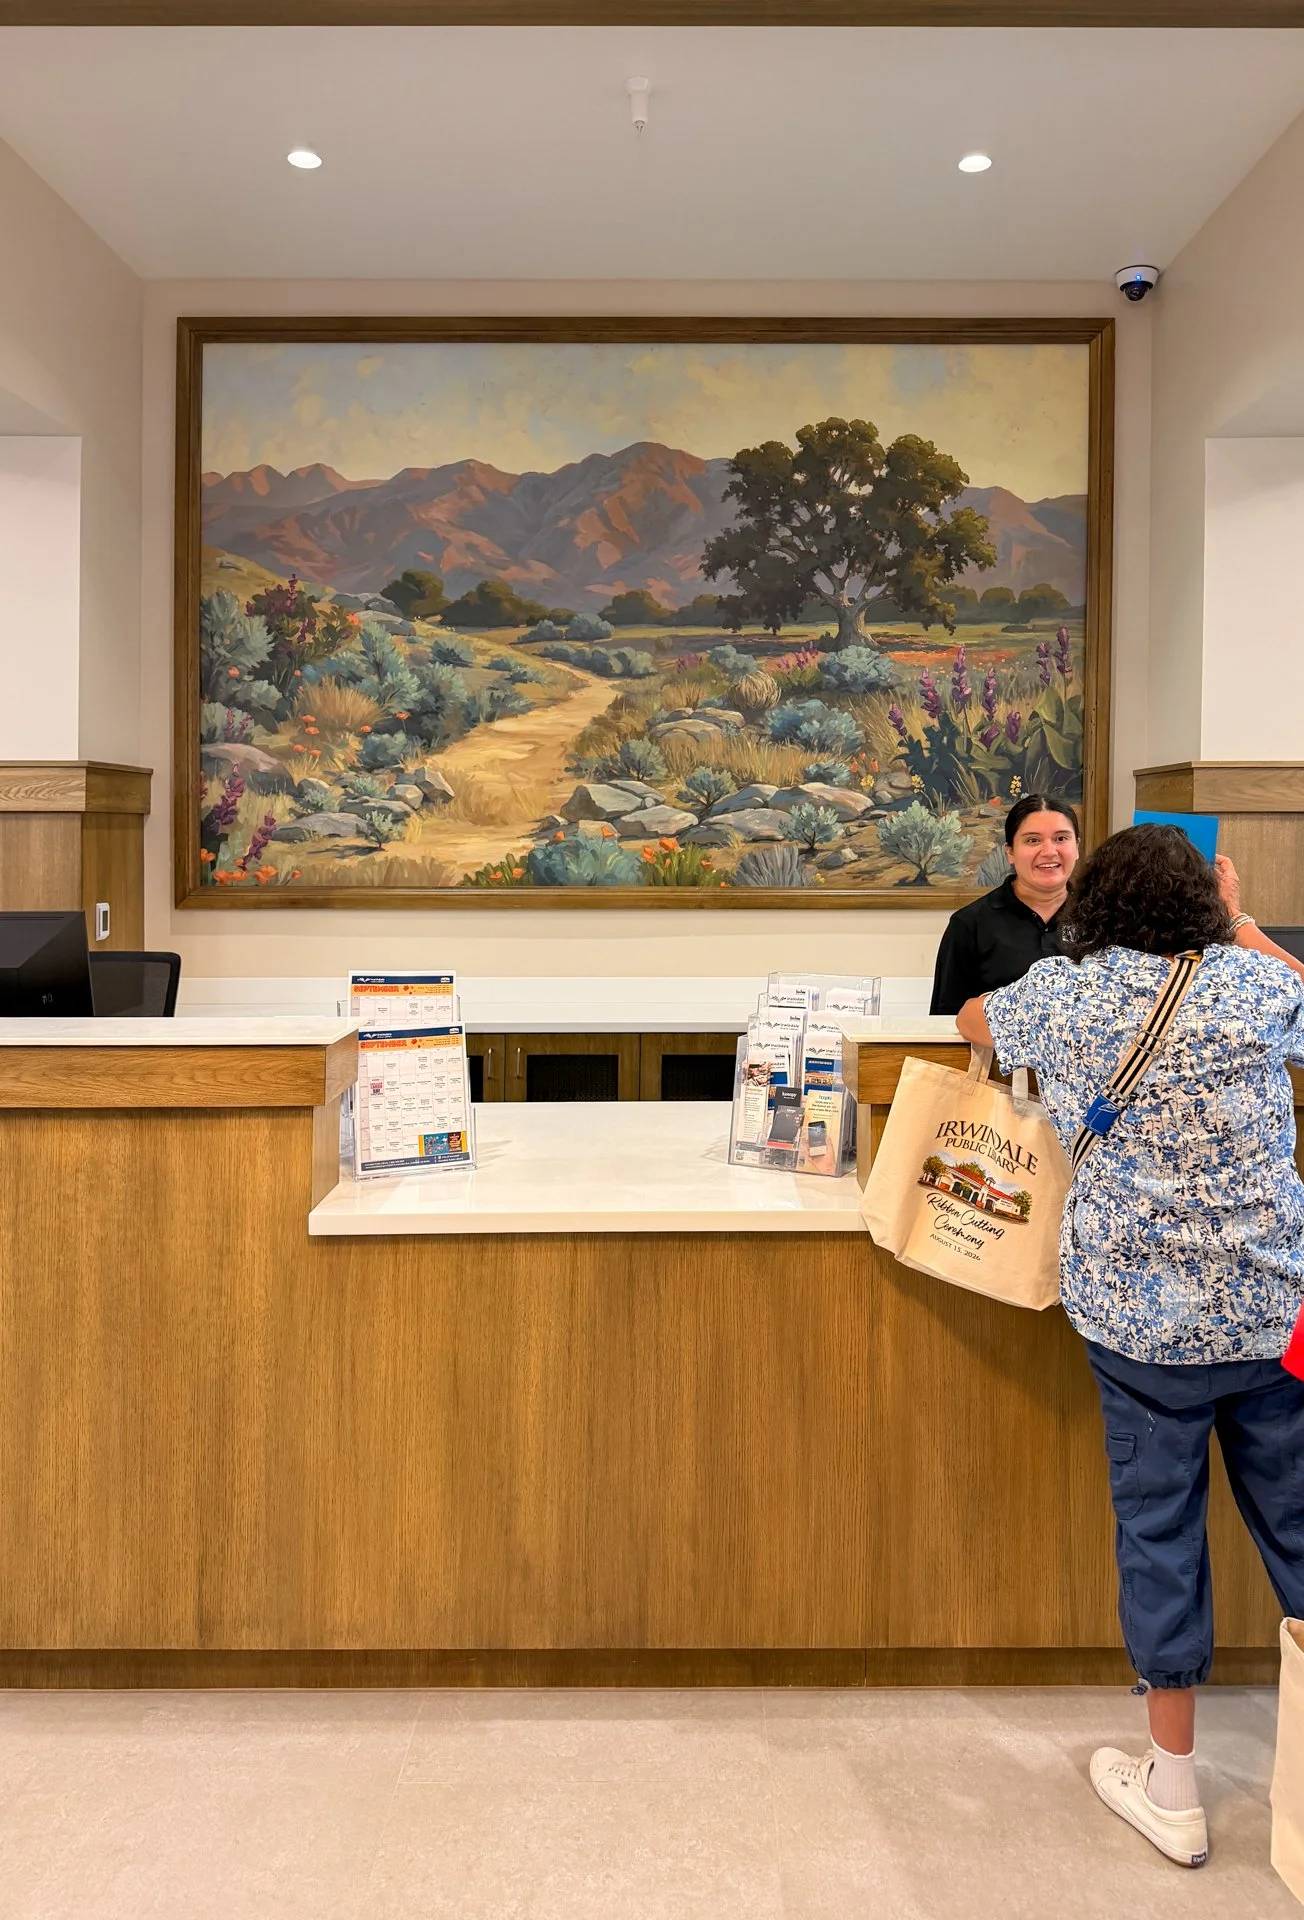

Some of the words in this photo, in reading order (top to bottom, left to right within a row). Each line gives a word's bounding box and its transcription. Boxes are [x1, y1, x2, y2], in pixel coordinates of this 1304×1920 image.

[353, 985, 399, 993] SEPTEMBER
[360, 1039, 407, 1049] SEPTEMBER
[944, 1137, 987, 1157] PUBLIC
[926, 1192, 961, 1219] Ribbon
[960, 1209, 1006, 1240] Cutting
[933, 1213, 985, 1250] Ceremony
[929, 1233, 953, 1249] AUGUST
[964, 1250, 981, 1261] 2026
